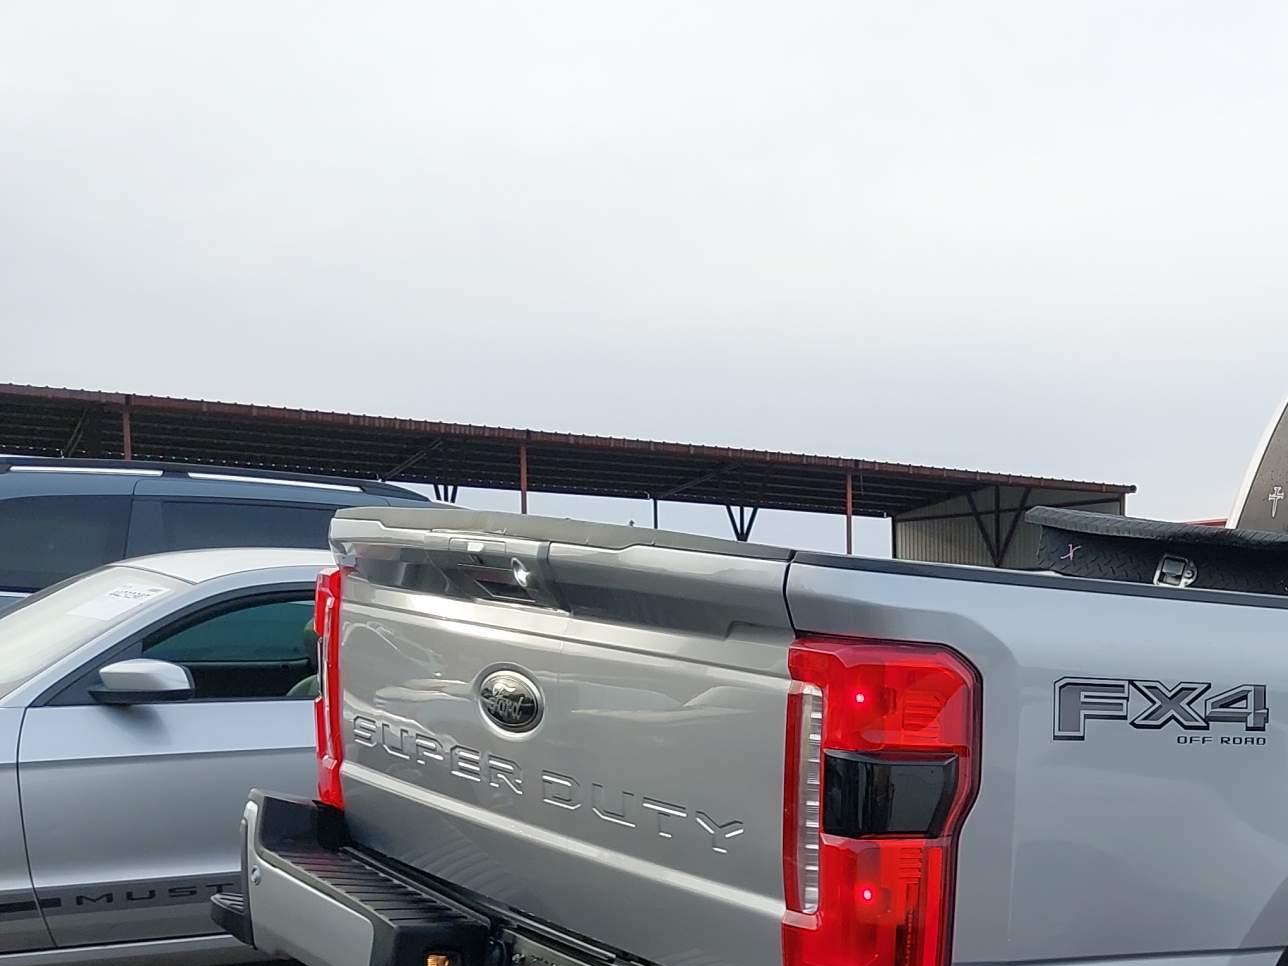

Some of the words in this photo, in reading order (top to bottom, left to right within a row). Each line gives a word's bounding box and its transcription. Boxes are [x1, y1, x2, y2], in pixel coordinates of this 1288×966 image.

[482, 683, 525, 721] Ford
[1052, 675, 1269, 741] FX4
[1176, 735, 1213, 745] OFF
[1219, 736, 1267, 746] ROAD
[353, 715, 523, 795] SUPER
[541, 769, 744, 854] DUTY
